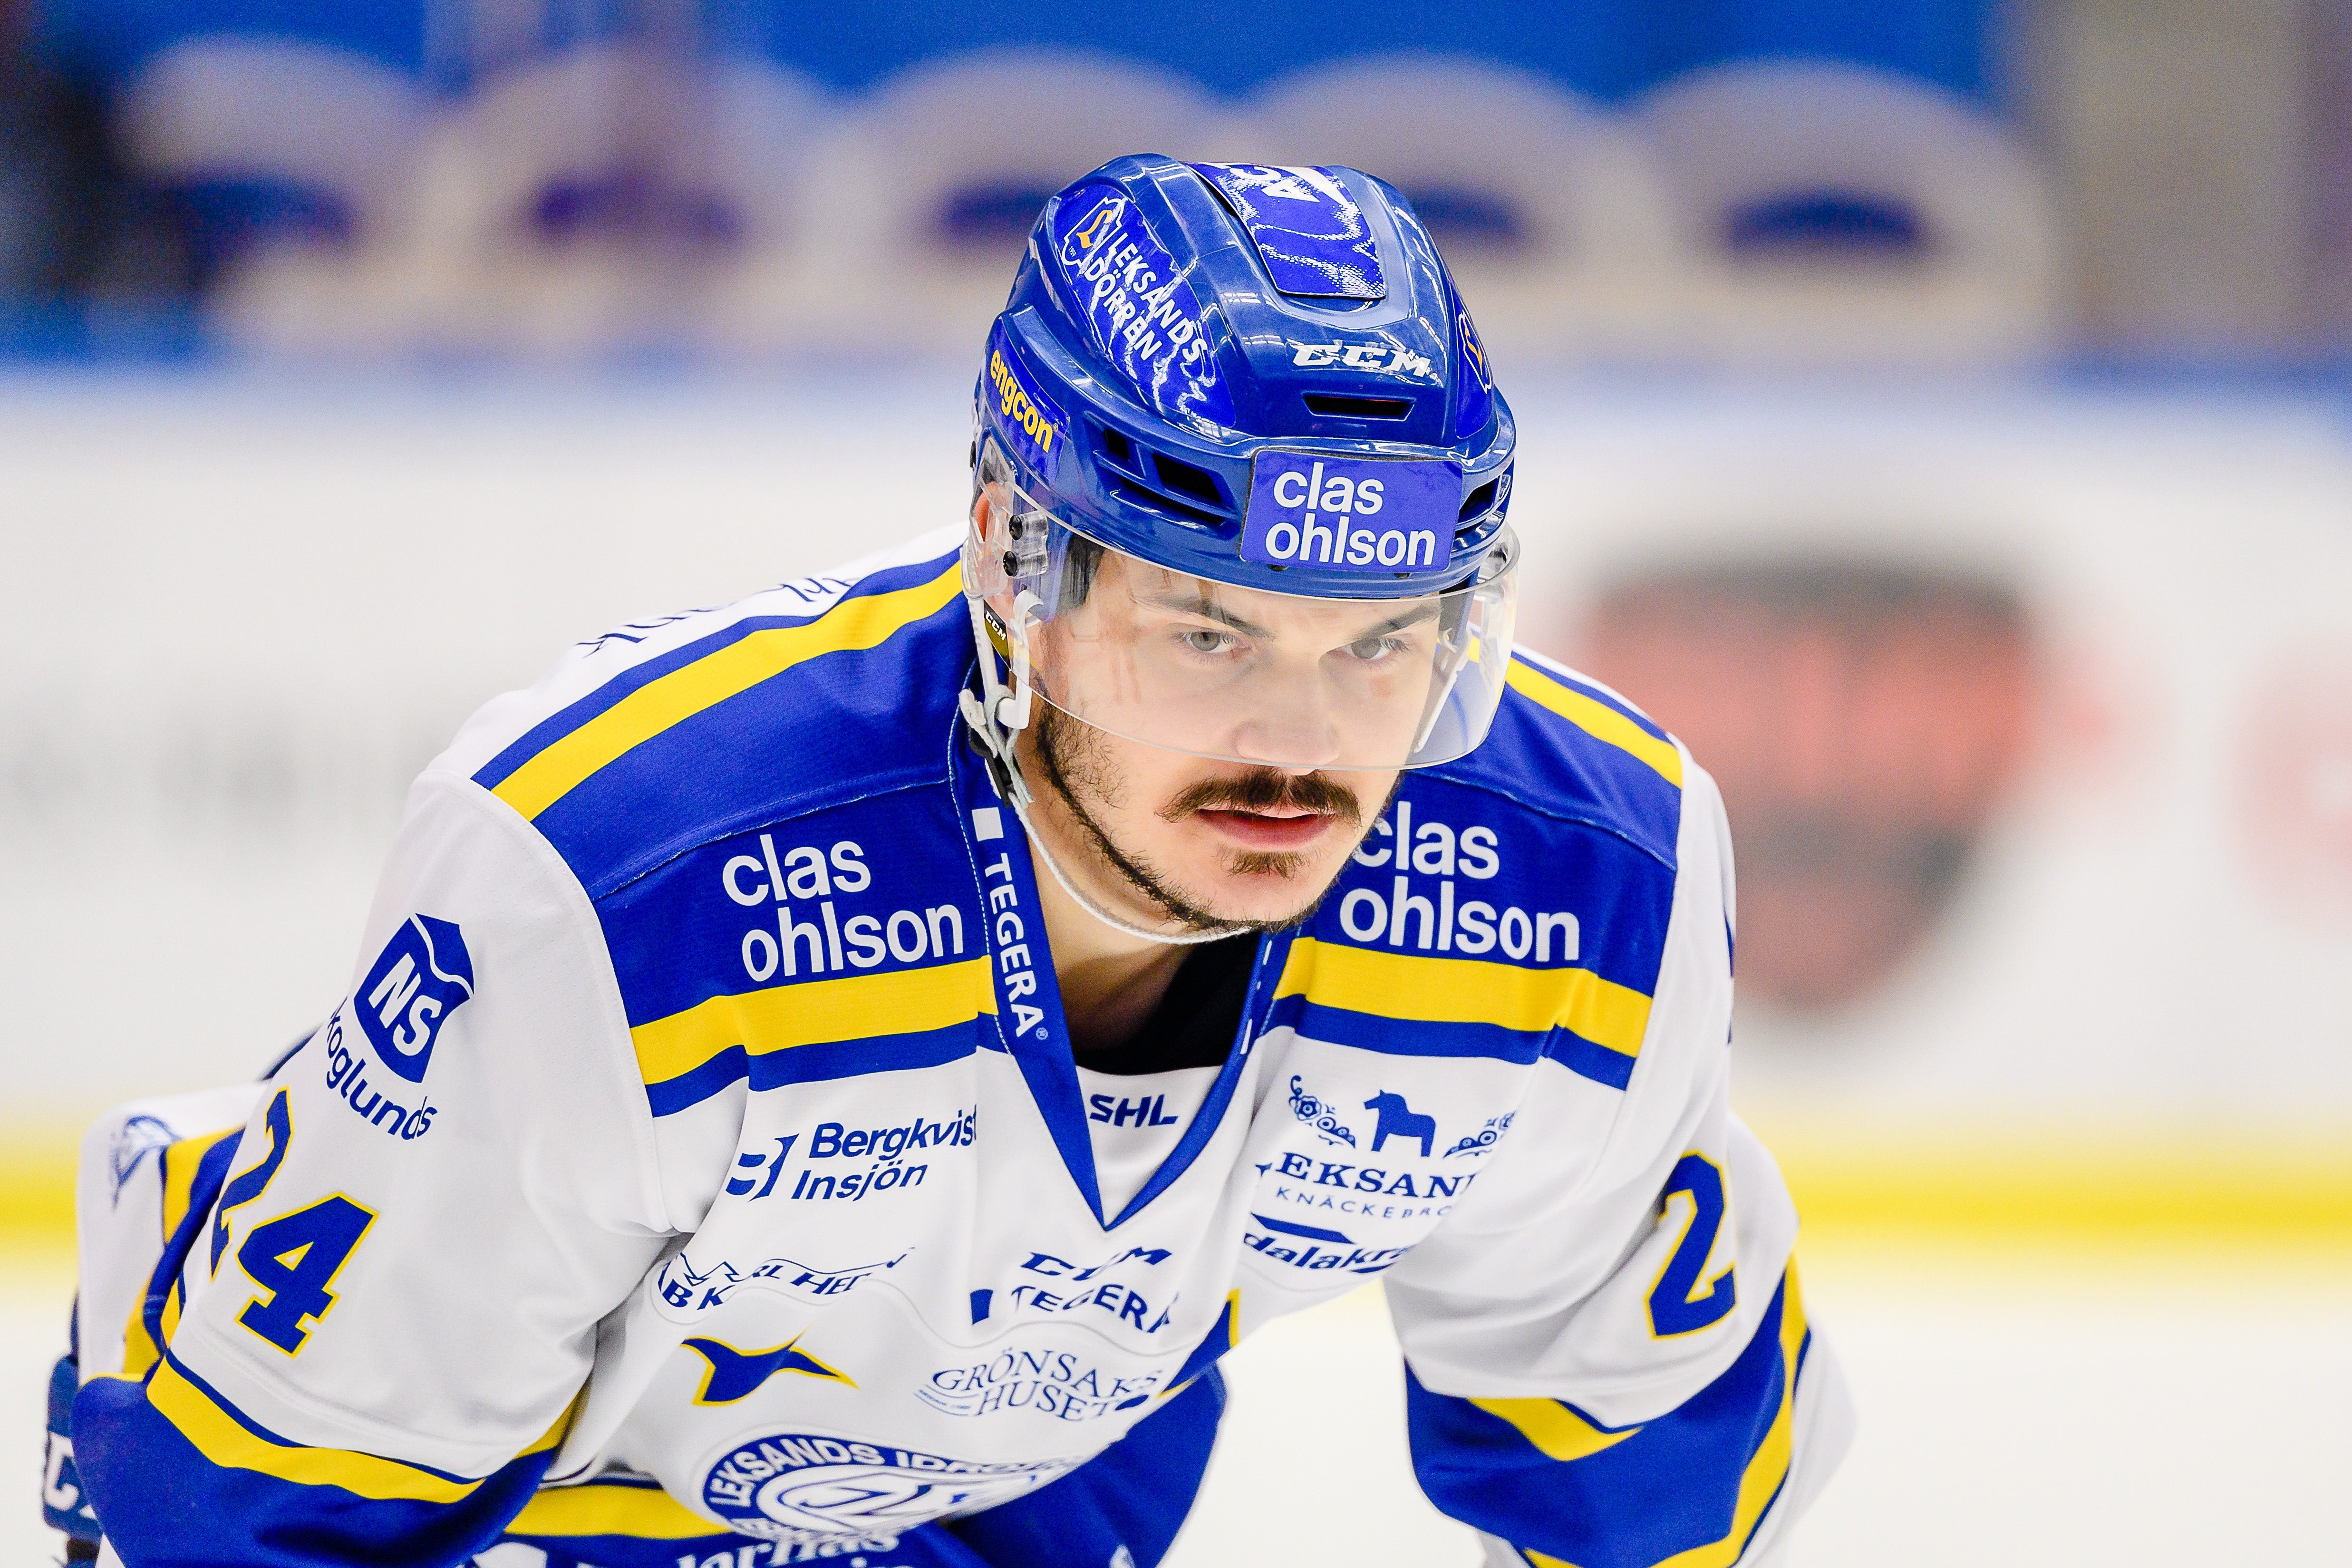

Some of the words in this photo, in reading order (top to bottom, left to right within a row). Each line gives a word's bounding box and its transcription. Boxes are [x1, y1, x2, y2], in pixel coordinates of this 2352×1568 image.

[1084, 256, 1162, 361] DÖRREN
[1108, 232, 1208, 363] LEKSANDS
[990, 349, 1053, 453] engcon
[1290, 344, 1431, 377] CCM
[1273, 462, 1384, 515] clas
[1265, 513, 1436, 566] ohlson
[985, 610, 1007, 641] CCM
[722, 834, 871, 906] clas
[742, 901, 964, 982] ohlson
[985, 852, 1044, 1037] TEGERA
[1339, 875, 1580, 962] ohlson
[368, 952, 442, 1056] NS
[326, 996, 438, 1141] koglunds
[1090, 1094, 1179, 1127] SHL
[791, 1159, 929, 1202] Insjön
